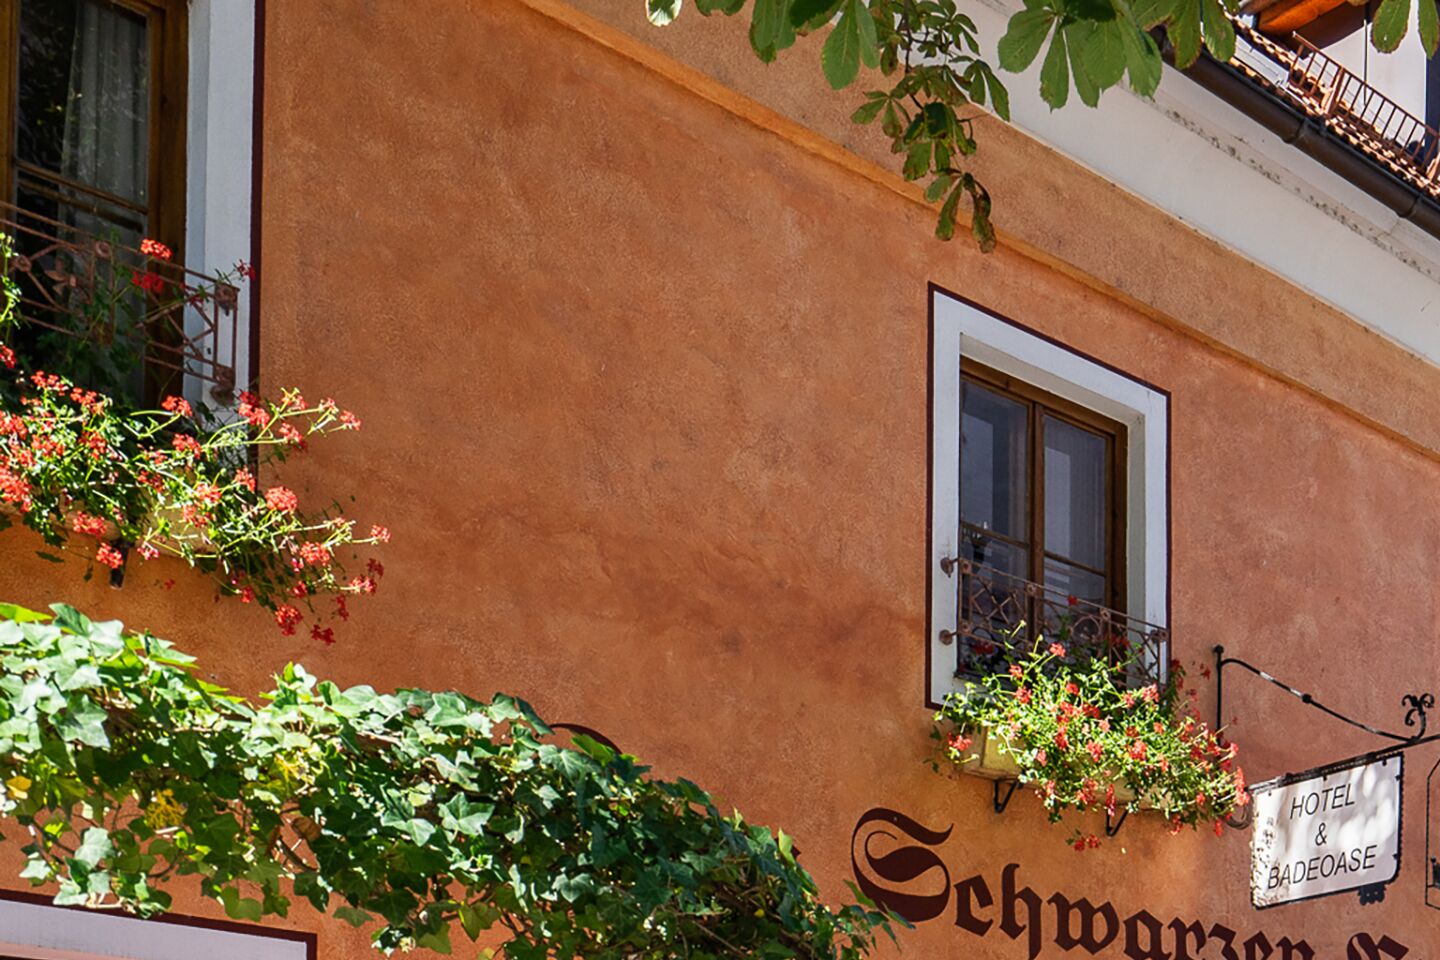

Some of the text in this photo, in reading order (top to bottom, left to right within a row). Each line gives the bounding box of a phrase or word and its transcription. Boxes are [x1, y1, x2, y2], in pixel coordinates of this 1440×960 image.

[1290, 783, 1355, 819] HOTEL
[1314, 822, 1328, 846] &
[1267, 844, 1378, 890] BADEOASE
